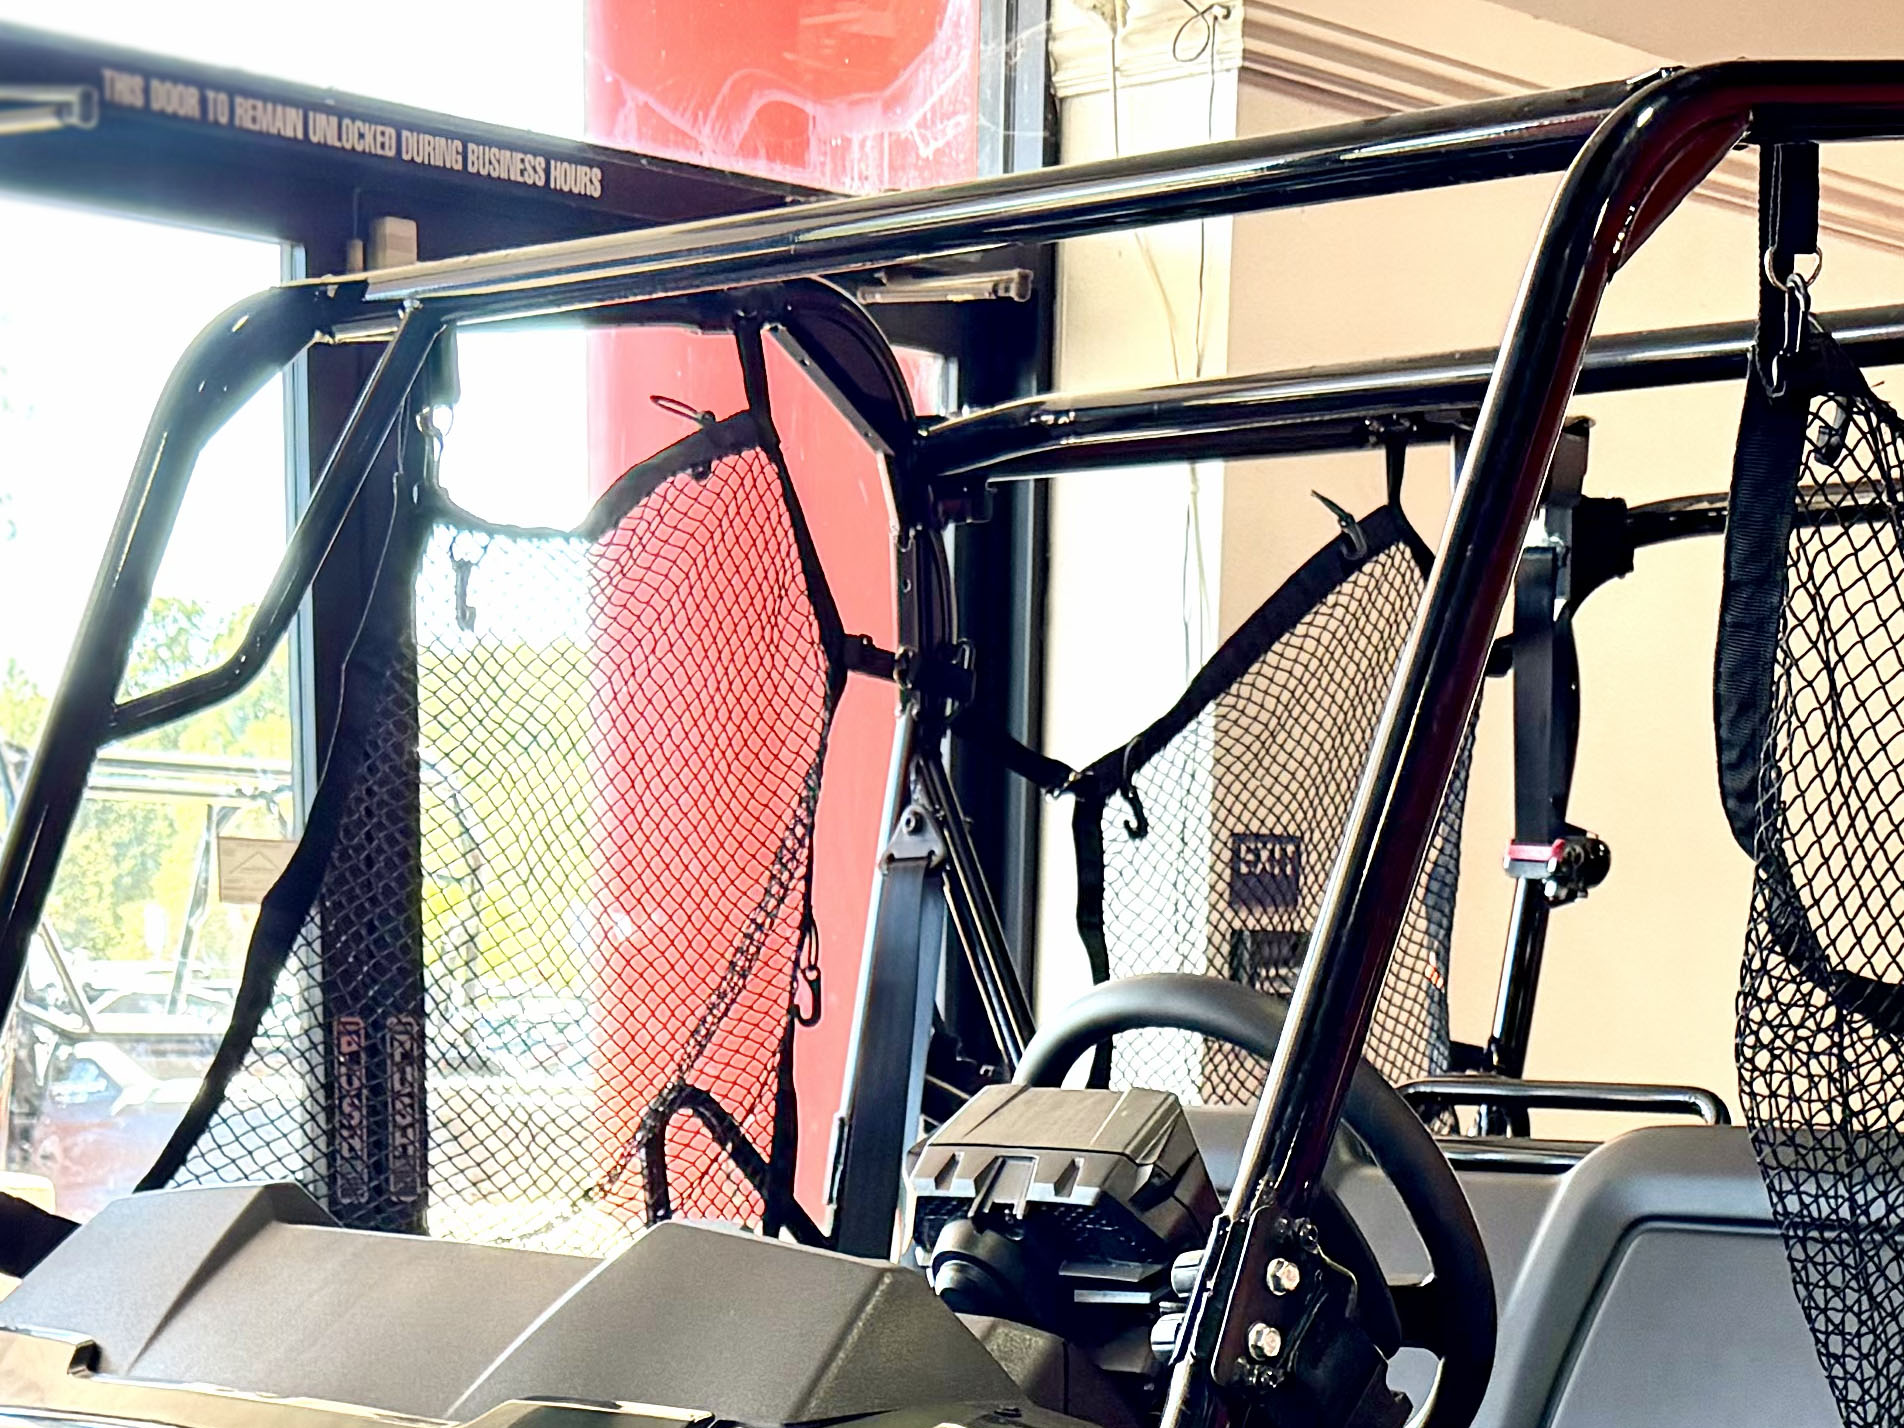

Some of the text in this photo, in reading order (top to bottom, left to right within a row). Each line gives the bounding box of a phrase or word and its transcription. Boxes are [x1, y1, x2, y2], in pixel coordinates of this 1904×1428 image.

[102, 67, 602, 199] THIS DOOR TO REMAIN UNLOCKED DURING BUSINESS HOURS
